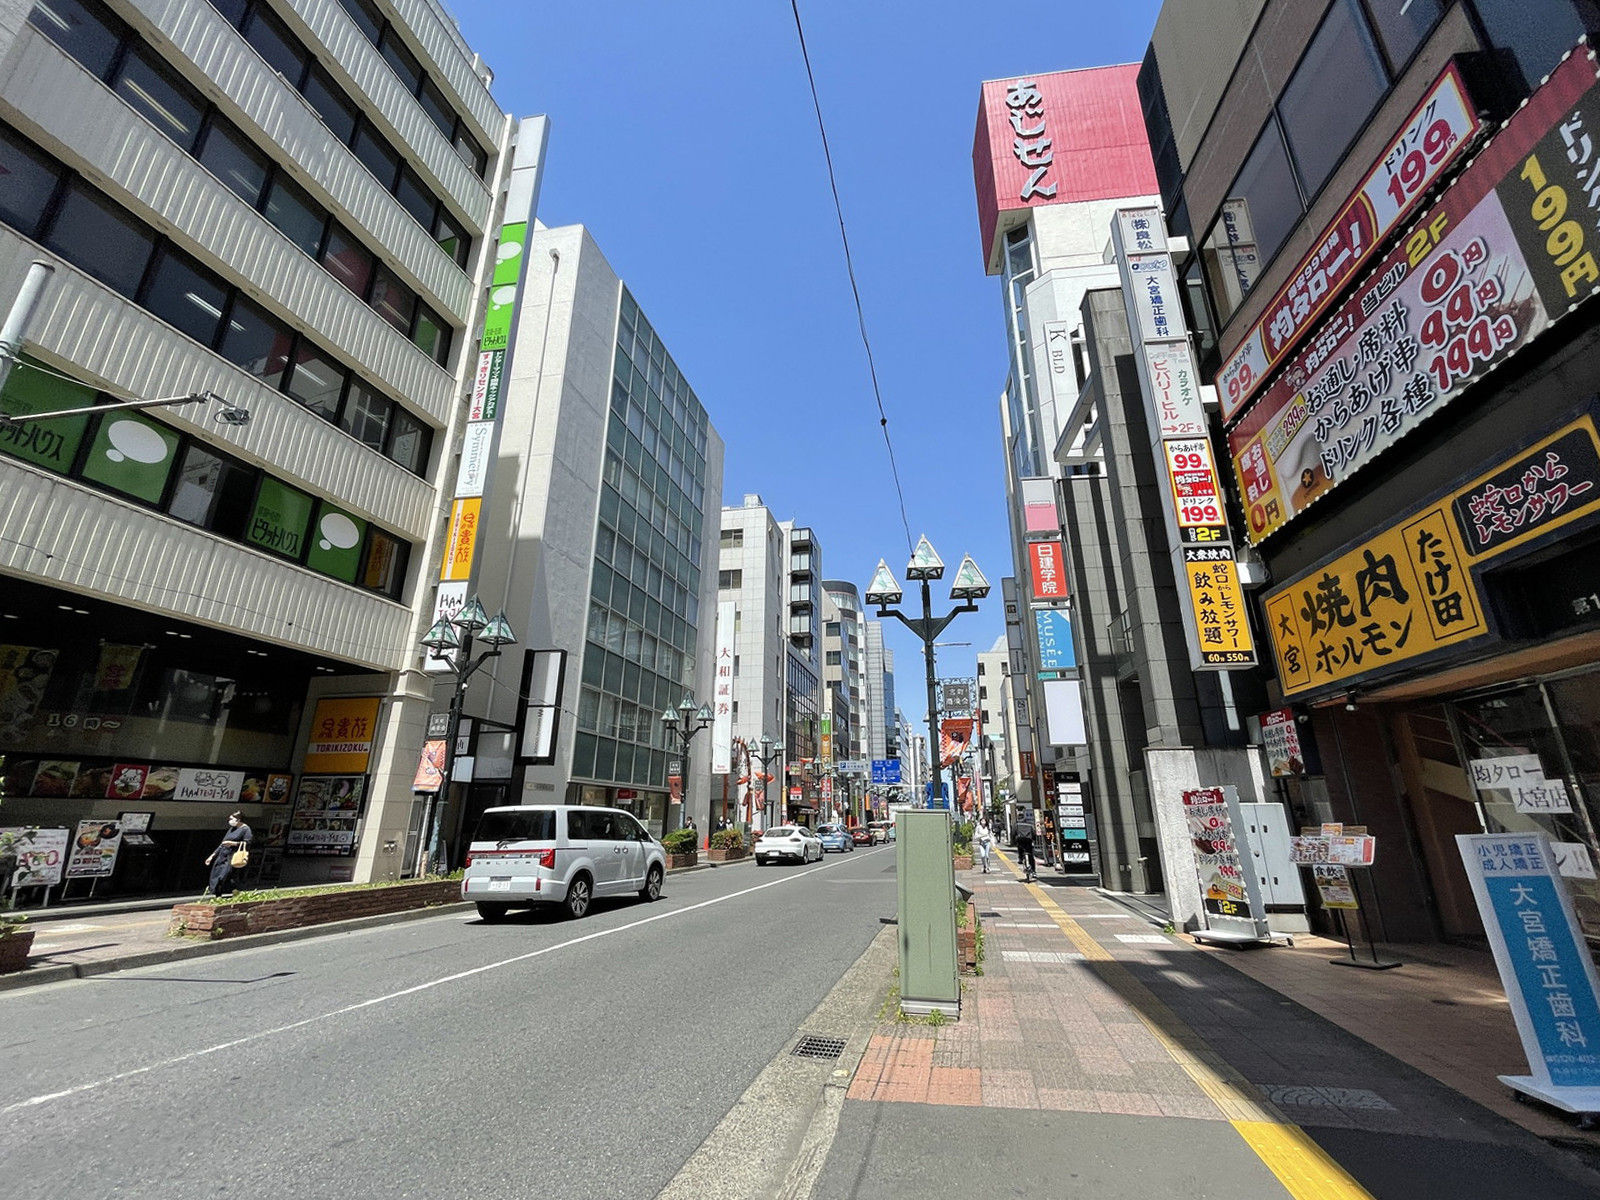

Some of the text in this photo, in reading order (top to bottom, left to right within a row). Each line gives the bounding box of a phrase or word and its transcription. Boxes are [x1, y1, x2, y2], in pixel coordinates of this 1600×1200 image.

[1005, 79, 1058, 202] あじせん
[1384, 99, 1437, 175] ドリンク
[1387, 118, 1458, 209] 199円
[1520, 154, 1600, 298] 199円
[1361, 211, 1449, 317] 当ビル 2F
[1146, 275, 1169, 336] 大宮矯正歯科
[1305, 238, 1486, 414] お通し・席料 0円
[1049, 329, 1067, 374] K BLD
[1314, 275, 1501, 442] からあげ串 99円
[1153, 360, 1179, 421] ビバリーヒル
[1178, 369, 1193, 406] カラオケ
[1228, 363, 1257, 404] 99円
[1319, 315, 1516, 478] ドリンク各種 199円
[1169, 441, 1205, 453] からあげ串
[1179, 423, 1194, 432] 2F
[1174, 453, 1208, 469] 99円
[1182, 496, 1215, 506] ドリンク
[1468, 452, 1569, 523] 蛇口から
[1476, 481, 1593, 544] レモンサワー
[252, 517, 299, 554] ピタットハウス
[455, 512, 475, 563] 鳥貴族
[1181, 505, 1220, 523] 199円
[1197, 527, 1221, 542] 2F
[1251, 498, 1280, 534] 0円
[1037, 544, 1058, 594] 日建学院
[1186, 548, 1231, 562] 大衆焼肉
[1417, 529, 1464, 626] たけ田
[440, 593, 463, 608] HAN
[1194, 571, 1224, 644] 飲み放題
[1301, 549, 1409, 639] 焼肉
[1278, 613, 1301, 674] 大宮
[1315, 608, 1413, 675] ホルモン
[717, 647, 731, 715] 大和証券
[316, 743, 364, 752] TORIKIZOKU
[318, 717, 369, 739] 鳥貴族
[1474, 764, 1541, 784] 均タロー
[1514, 786, 1569, 808] 大宮店
[1478, 843, 1539, 857] 小児矯正
[1482, 857, 1543, 871] 成人矯正
[1222, 901, 1237, 914] 2F
[1509, 882, 1587, 1047] 大宮矯正歯科
